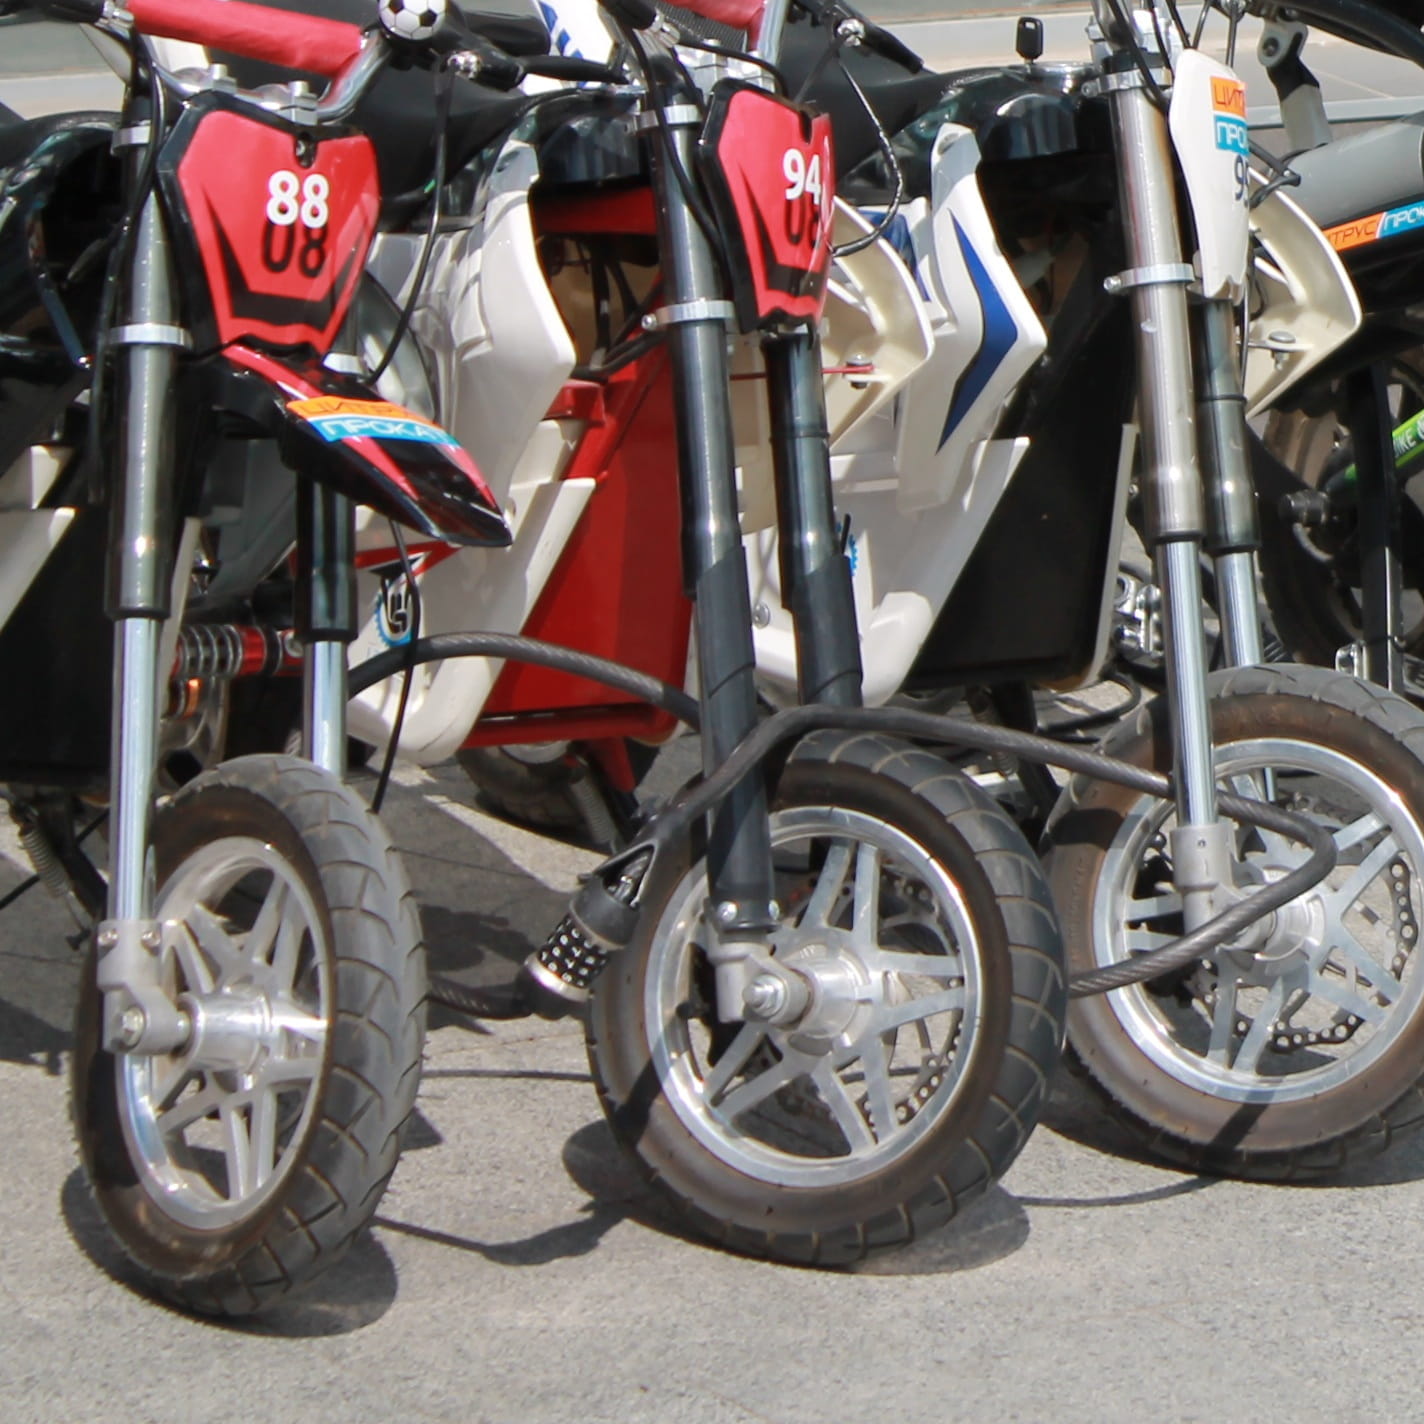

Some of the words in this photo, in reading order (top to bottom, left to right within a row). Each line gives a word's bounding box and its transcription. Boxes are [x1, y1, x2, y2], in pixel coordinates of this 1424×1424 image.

[266, 170, 329, 228] 88
[783, 148, 821, 205] 94
[1327, 219, 1378, 246] ТРУС
